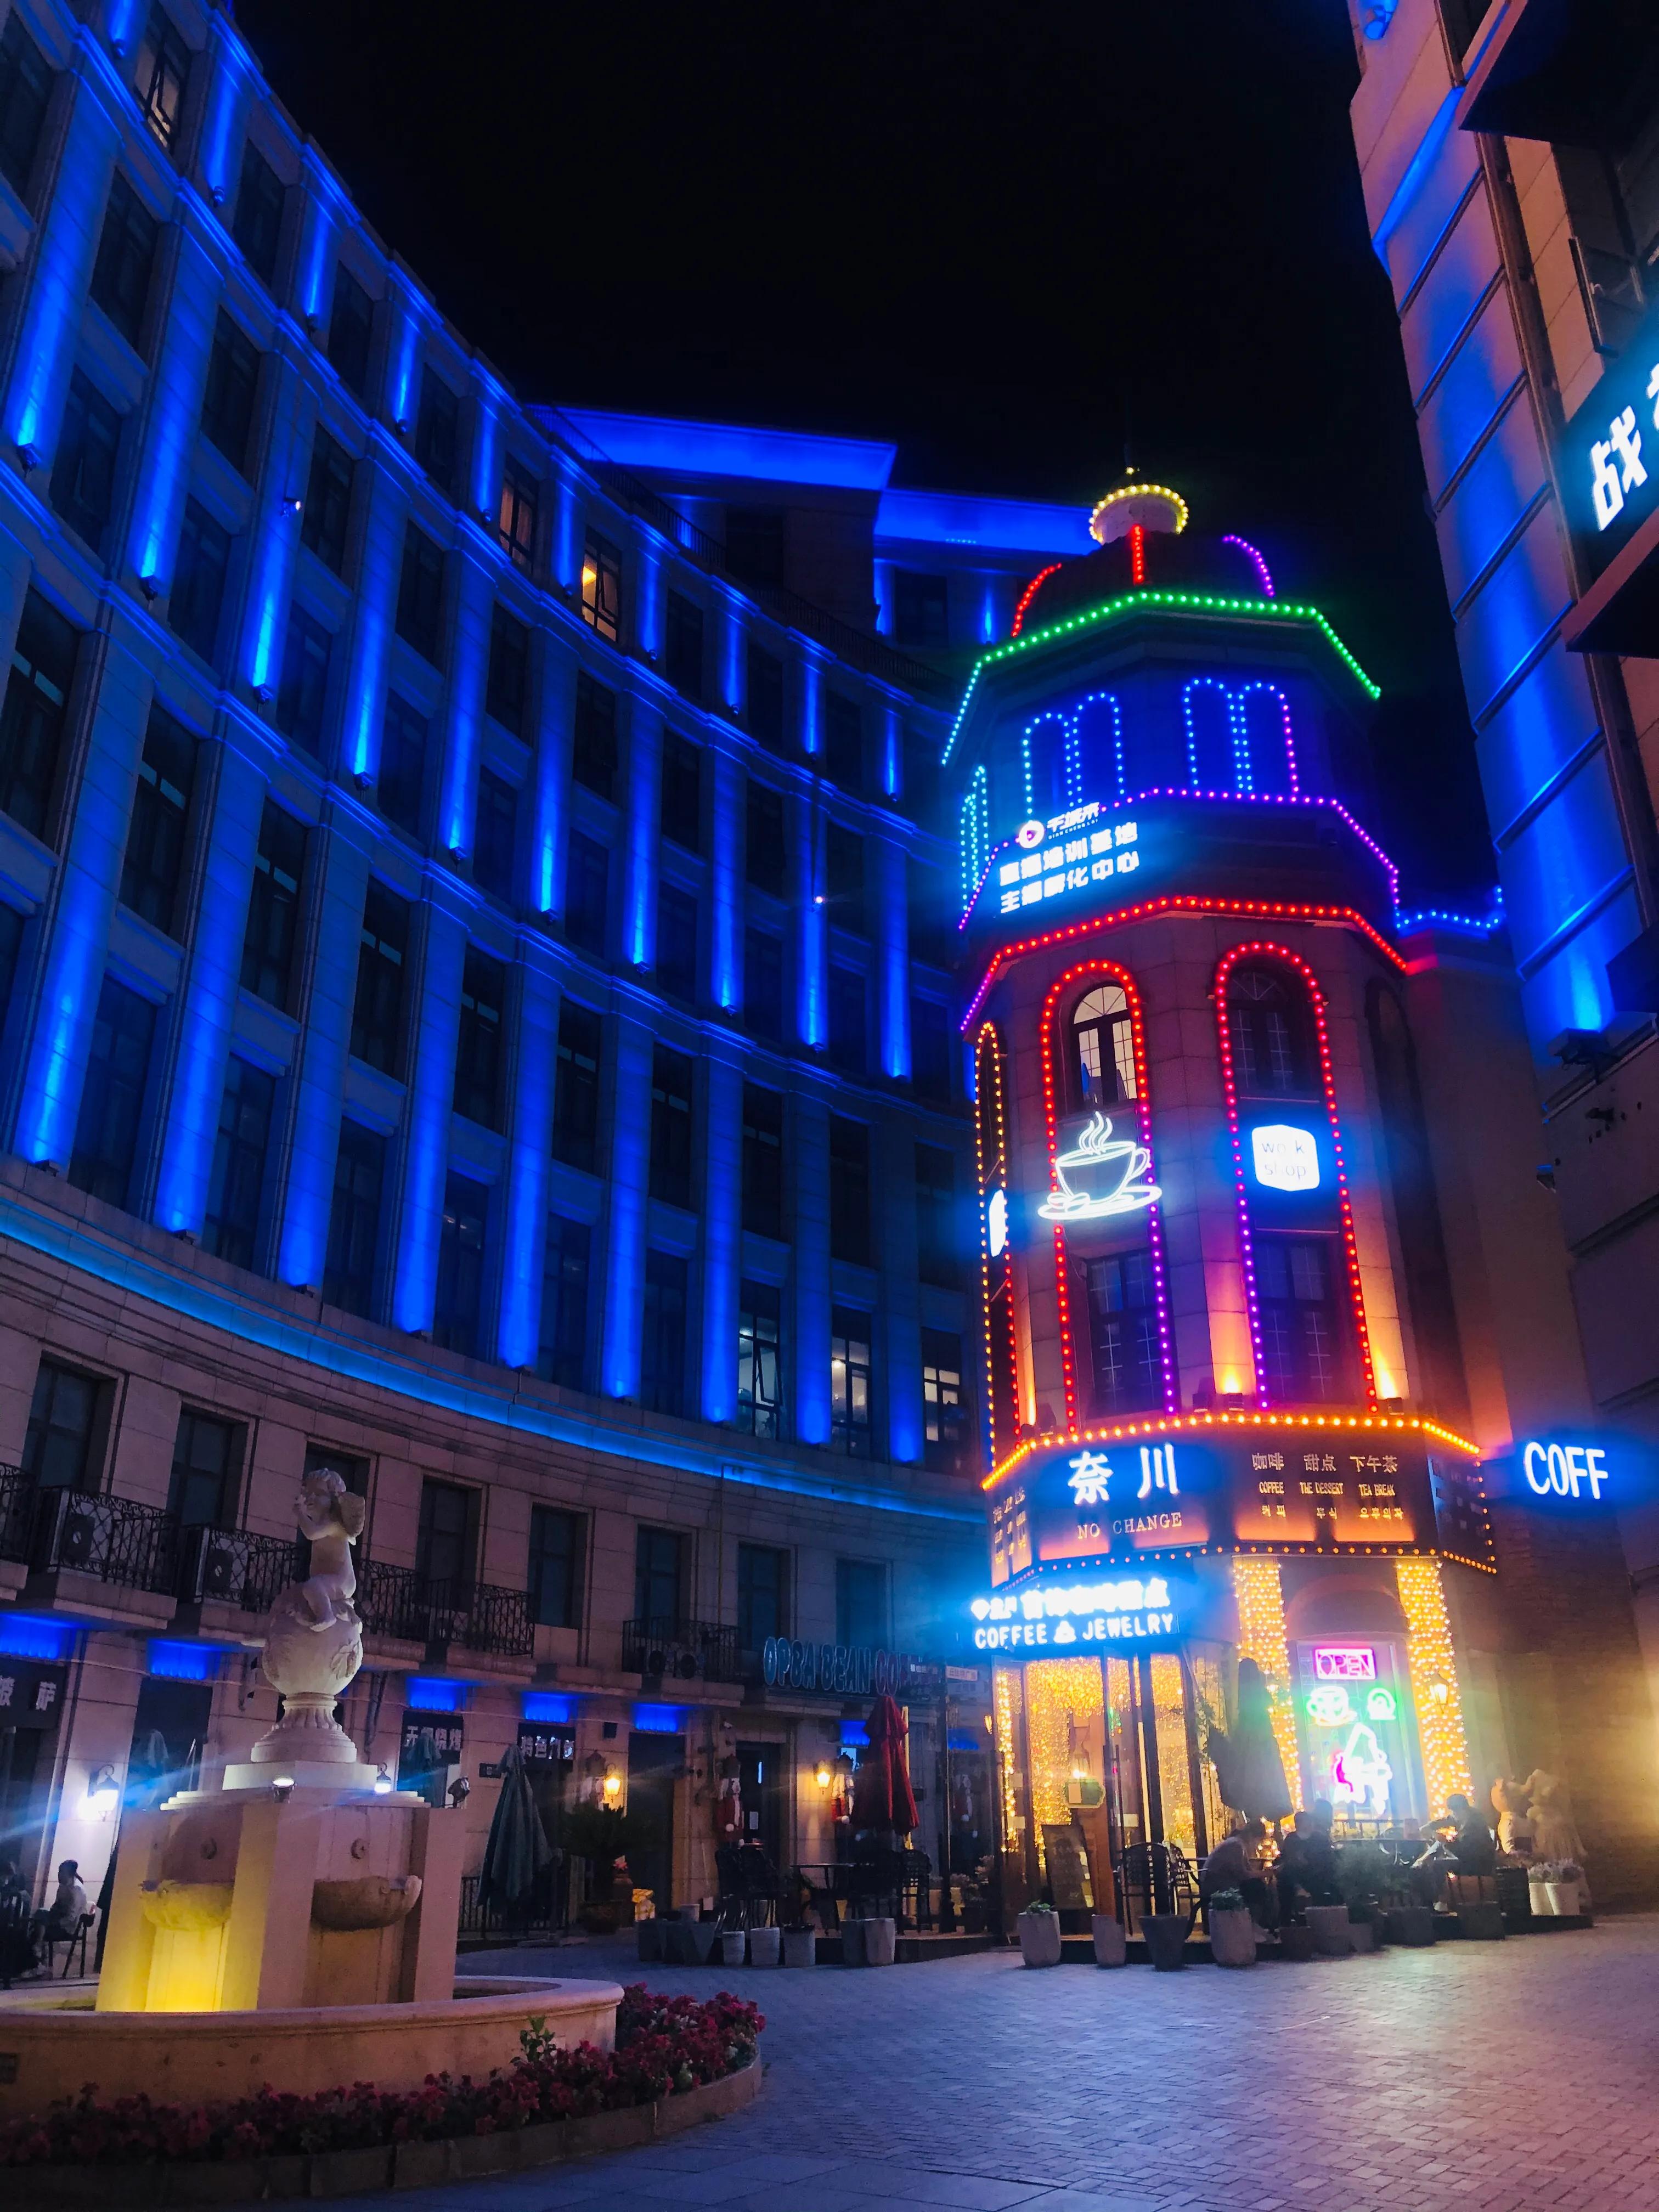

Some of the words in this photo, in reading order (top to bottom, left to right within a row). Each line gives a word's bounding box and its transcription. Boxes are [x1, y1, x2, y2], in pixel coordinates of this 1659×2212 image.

[1262, 1140, 1305, 1154] wok
[1252, 1452, 1284, 1471] 咖啡
[1304, 1453, 1337, 1472] 甜点
[1349, 1455, 1398, 1473] 下午茶
[1524, 1441, 1609, 1500] COFF
[1259, 1481, 1285, 1494] COFFEE
[1299, 1482, 1313, 1494] THE
[1315, 1482, 1344, 1495] DESSERT
[1358, 1483, 1373, 1497] TEA
[1374, 1483, 1396, 1497] BREAK
[1077, 1522, 1101, 1540] NO
[1113, 1512, 1182, 1534] CHANGE
[975, 1623, 1048, 1649] COFFEE
[1082, 1612, 1173, 1640] JEWELRY
[1317, 1654, 1373, 1677] OPEN
